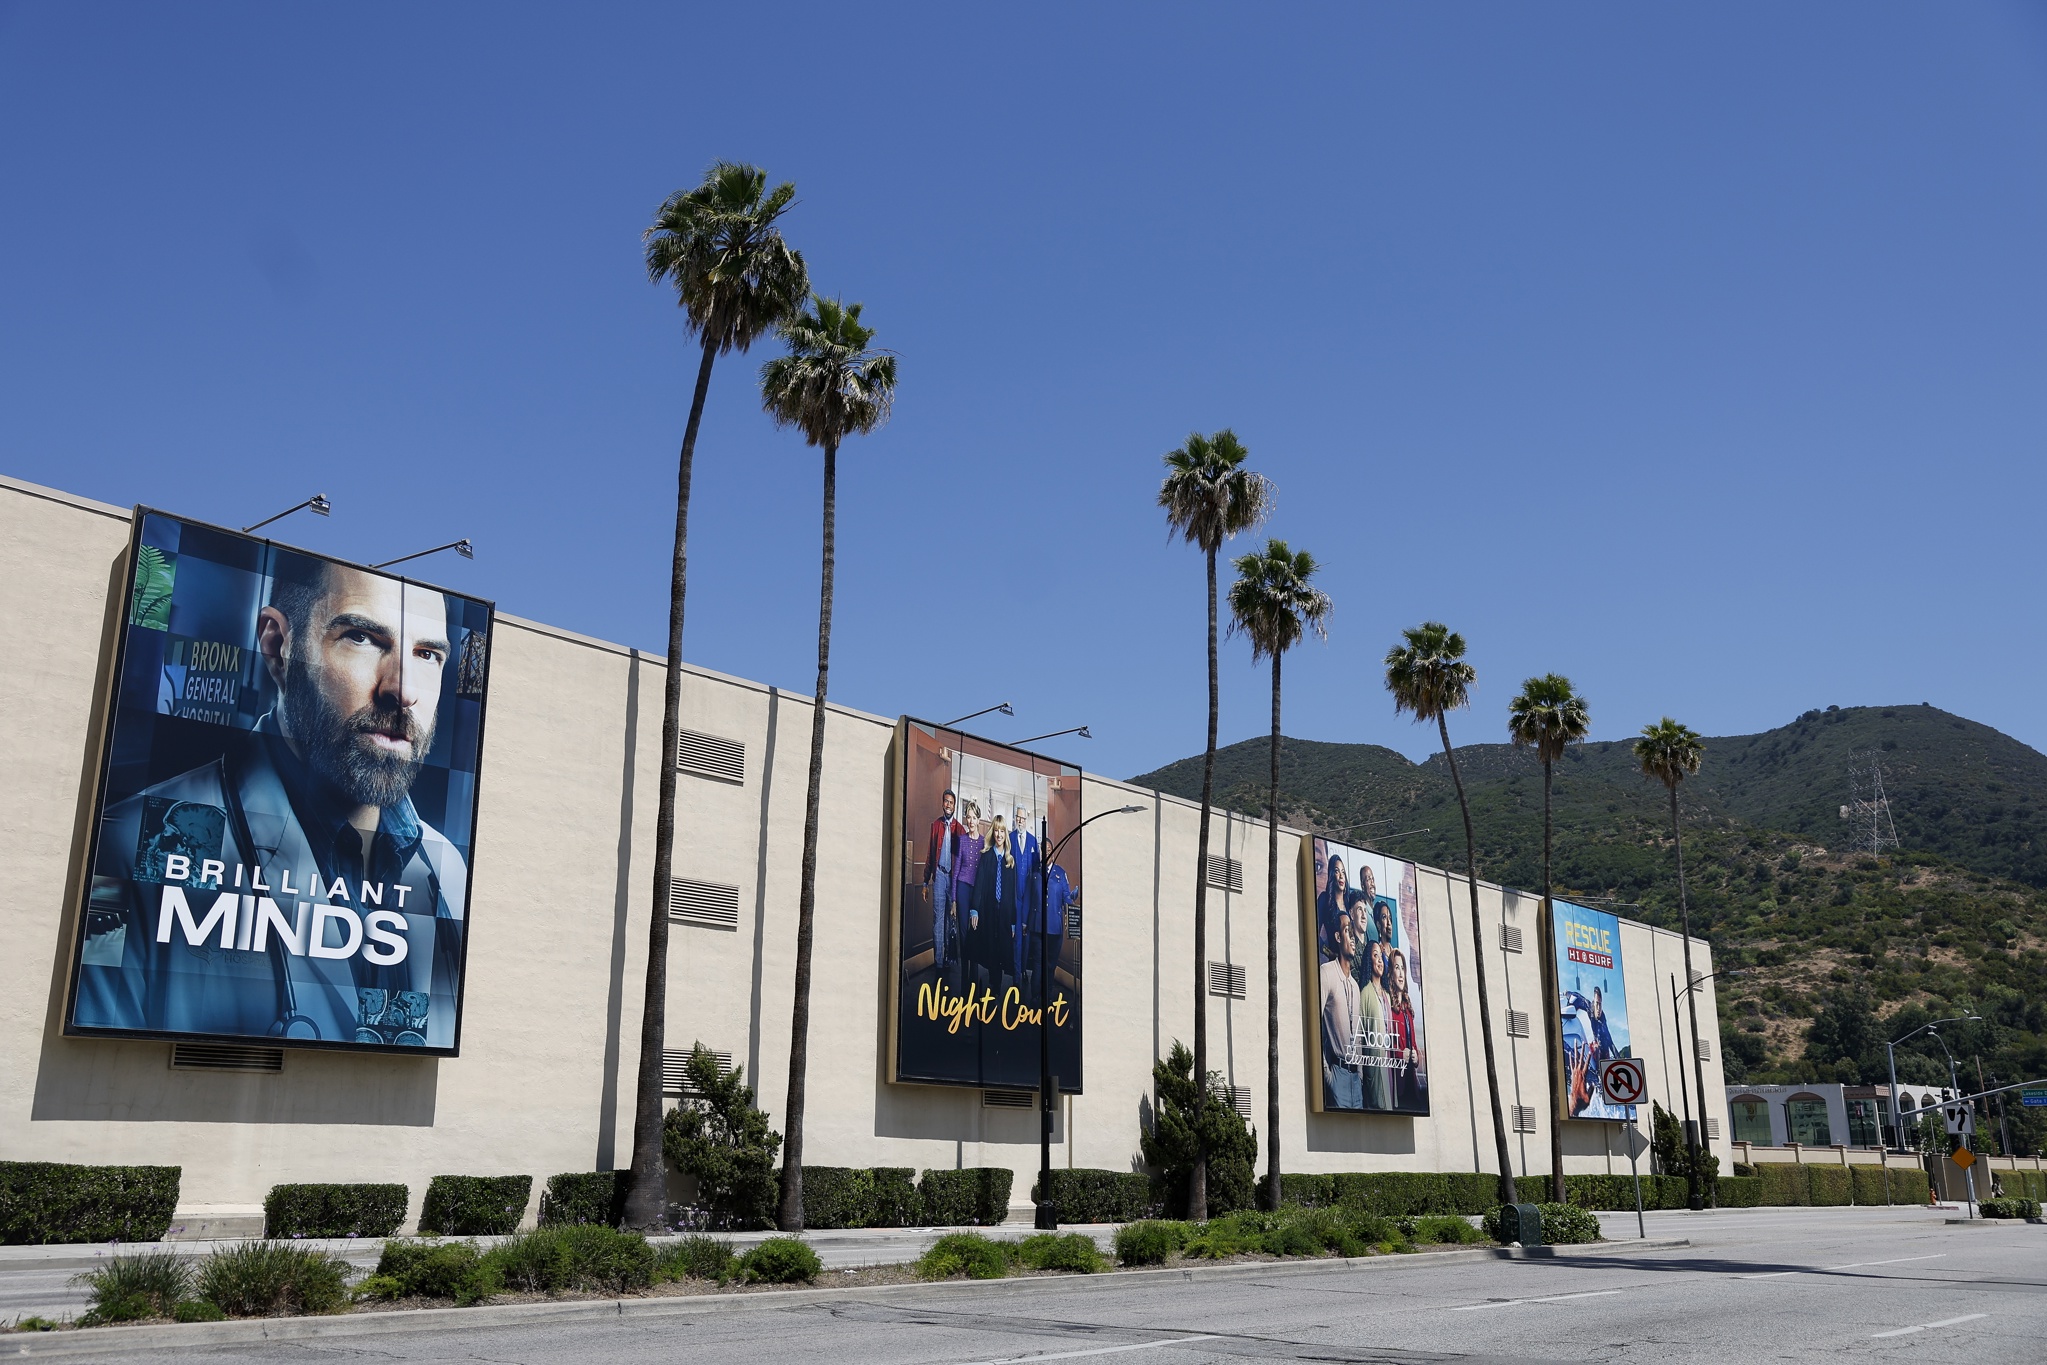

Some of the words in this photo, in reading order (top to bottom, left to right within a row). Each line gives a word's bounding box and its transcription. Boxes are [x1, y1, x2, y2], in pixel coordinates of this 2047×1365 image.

[190, 641, 240, 672] BRONX
[186, 676, 235, 705] GENERAL
[165, 853, 412, 908] BRILLIANT
[156, 885, 409, 966] MINDS
[1565, 921, 1612, 953] RESCUE
[1569, 950, 1580, 961] HI
[1588, 953, 1612, 967] SURF
[917, 977, 998, 1035] Night
[1353, 1016, 1400, 1050] Abbott
[1345, 1045, 1408, 1077] Elementary
